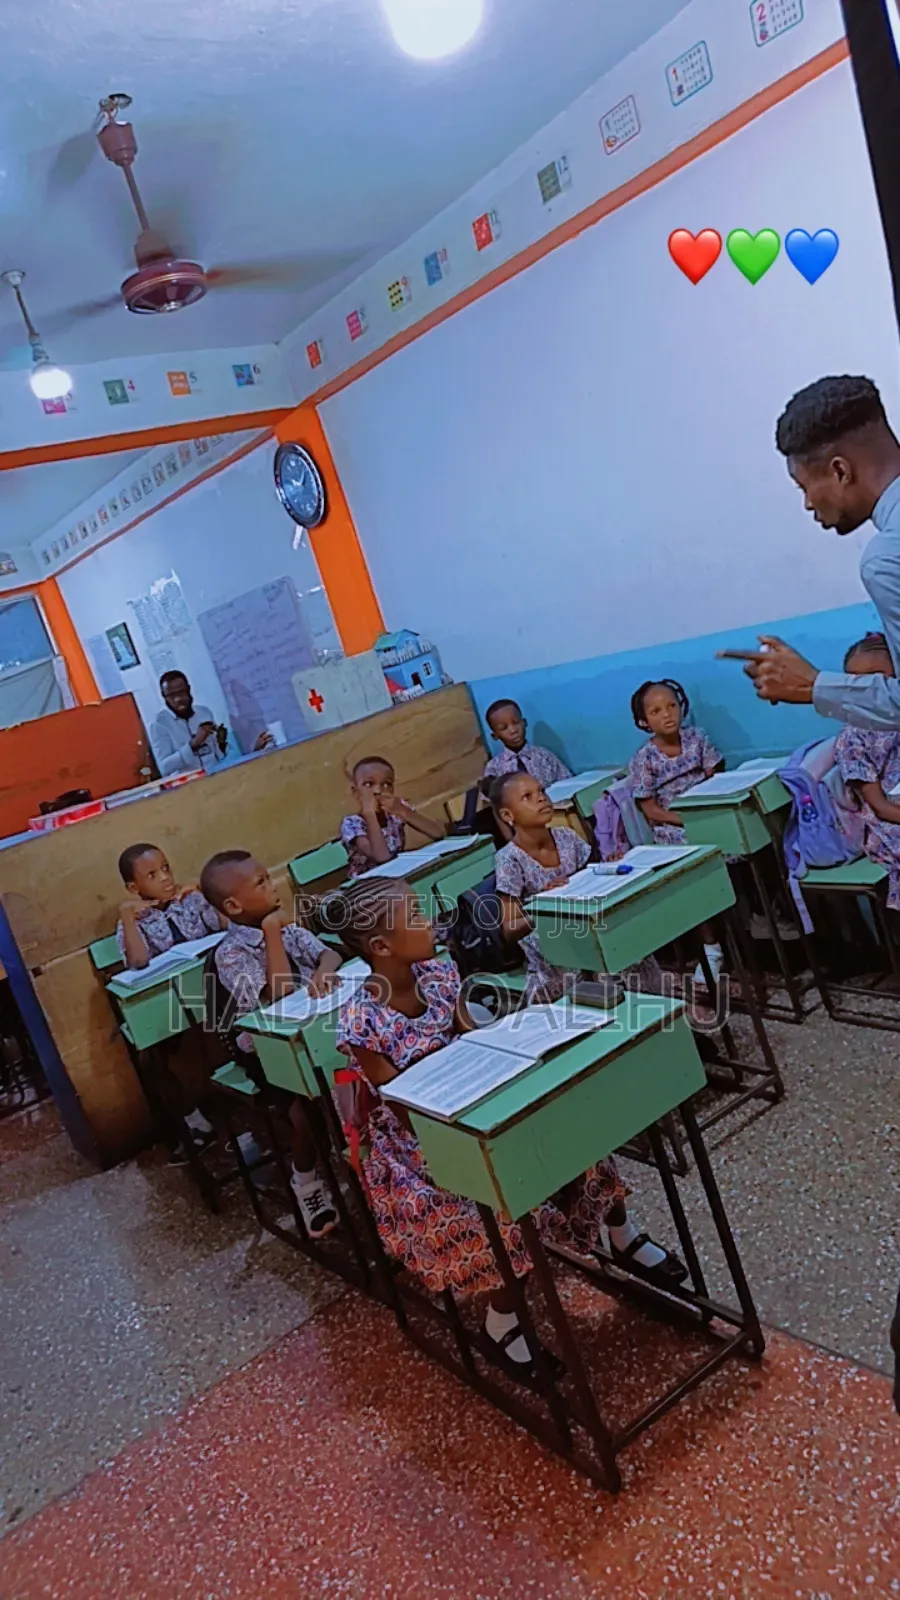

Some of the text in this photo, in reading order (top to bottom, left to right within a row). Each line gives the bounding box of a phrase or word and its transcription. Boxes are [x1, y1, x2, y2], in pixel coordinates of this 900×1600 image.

[756, 3, 766, 21] 2
[672, 67, 679, 82] 1
[253, 364, 261, 374] 6
[190, 372, 197, 383] 5
[128, 380, 135, 391] 4
